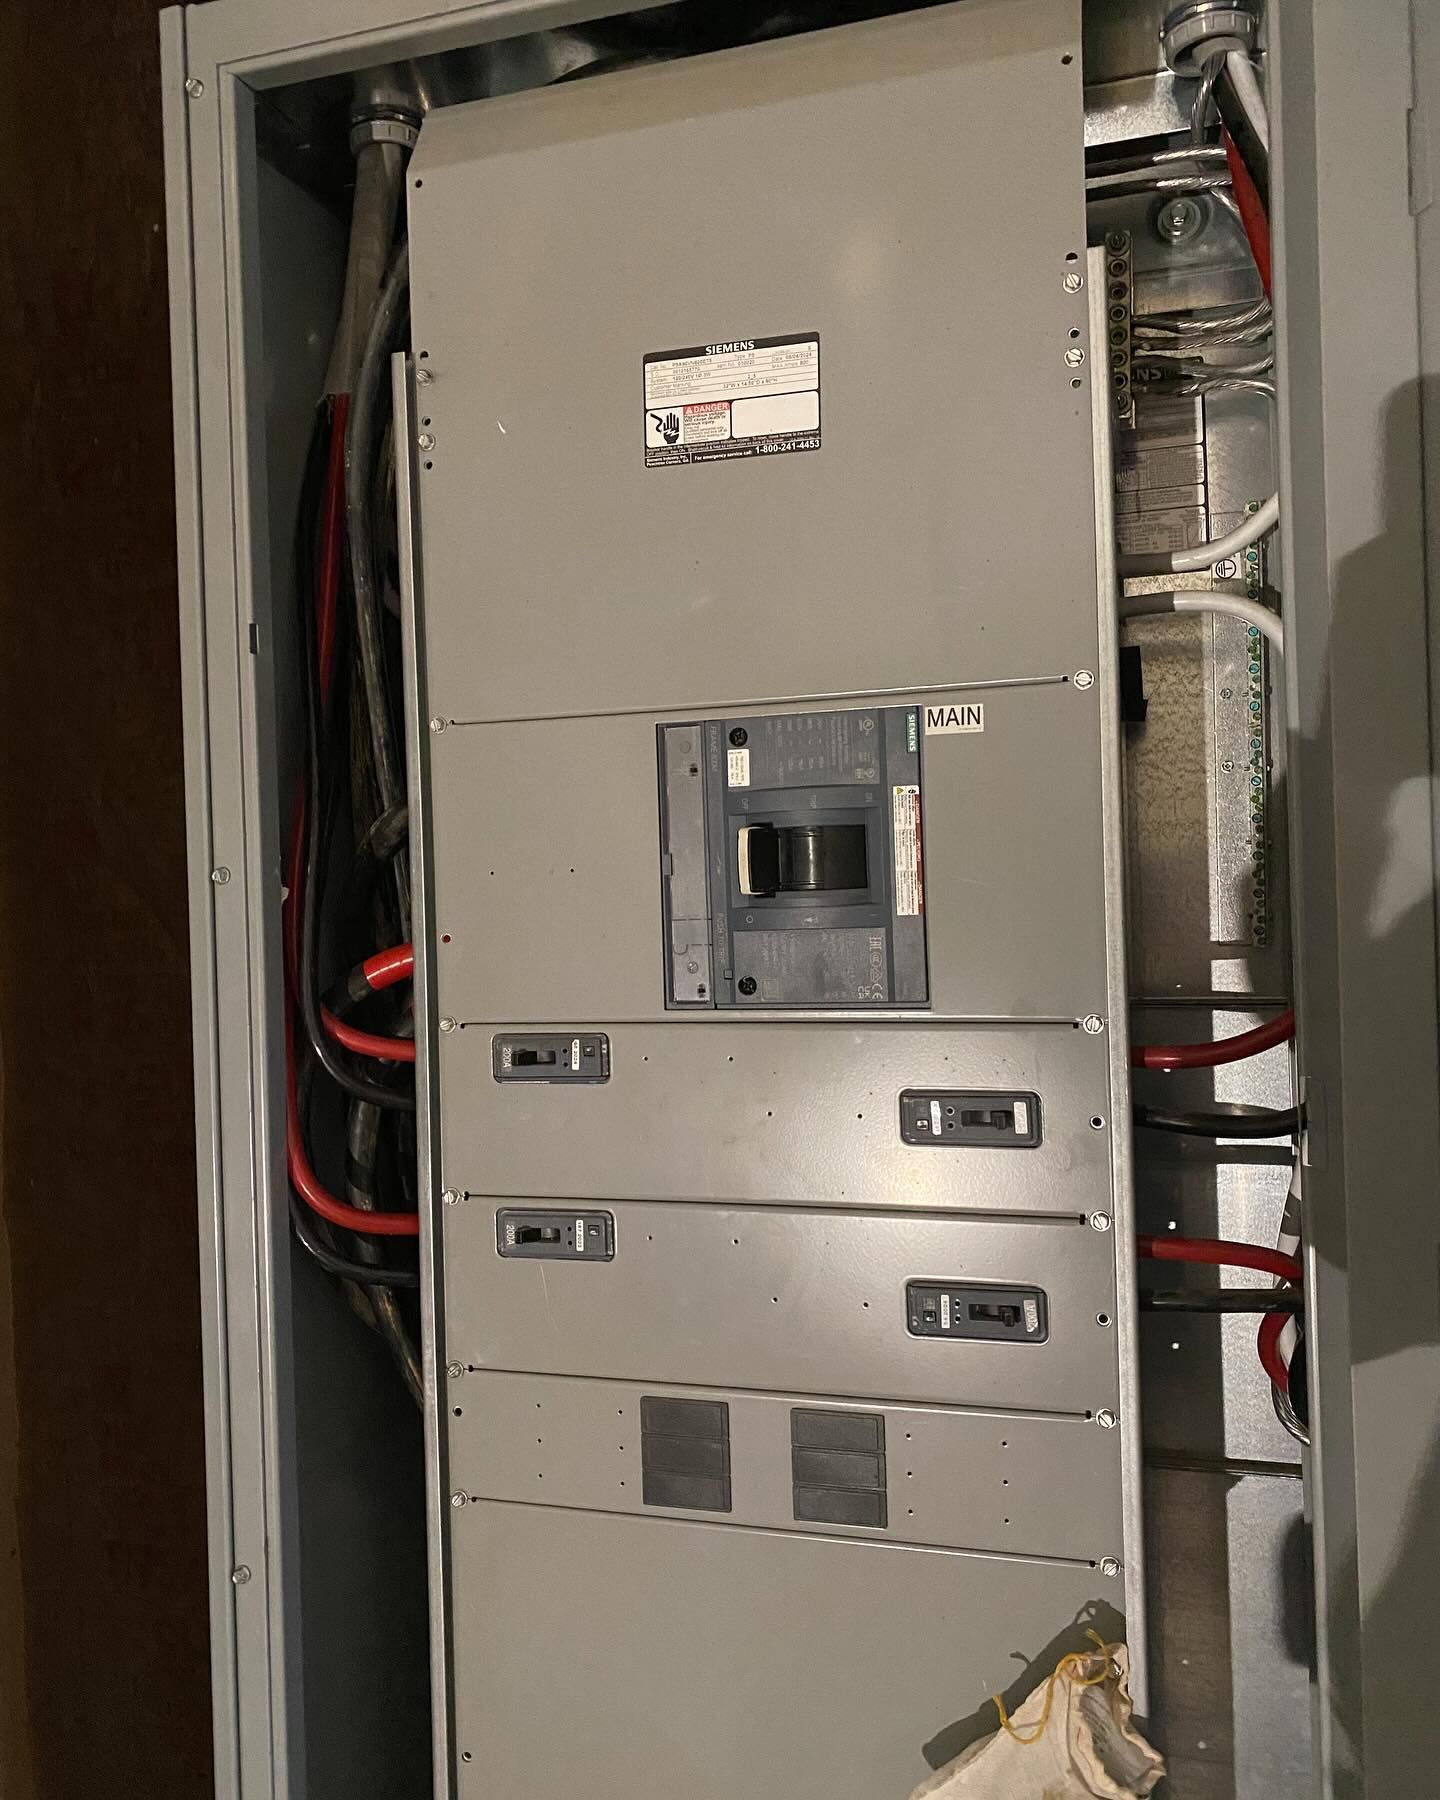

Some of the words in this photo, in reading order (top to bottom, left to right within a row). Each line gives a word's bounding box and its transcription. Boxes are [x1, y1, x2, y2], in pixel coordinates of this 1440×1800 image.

[706, 341, 754, 355] SIEMENS
[694, 403, 728, 412] DANGER
[756, 440, 819, 454] 1-800-241-4453
[927, 706, 981, 728] MAIN
[503, 1048, 511, 1068] 200A
[506, 1224, 515, 1245] 200A
